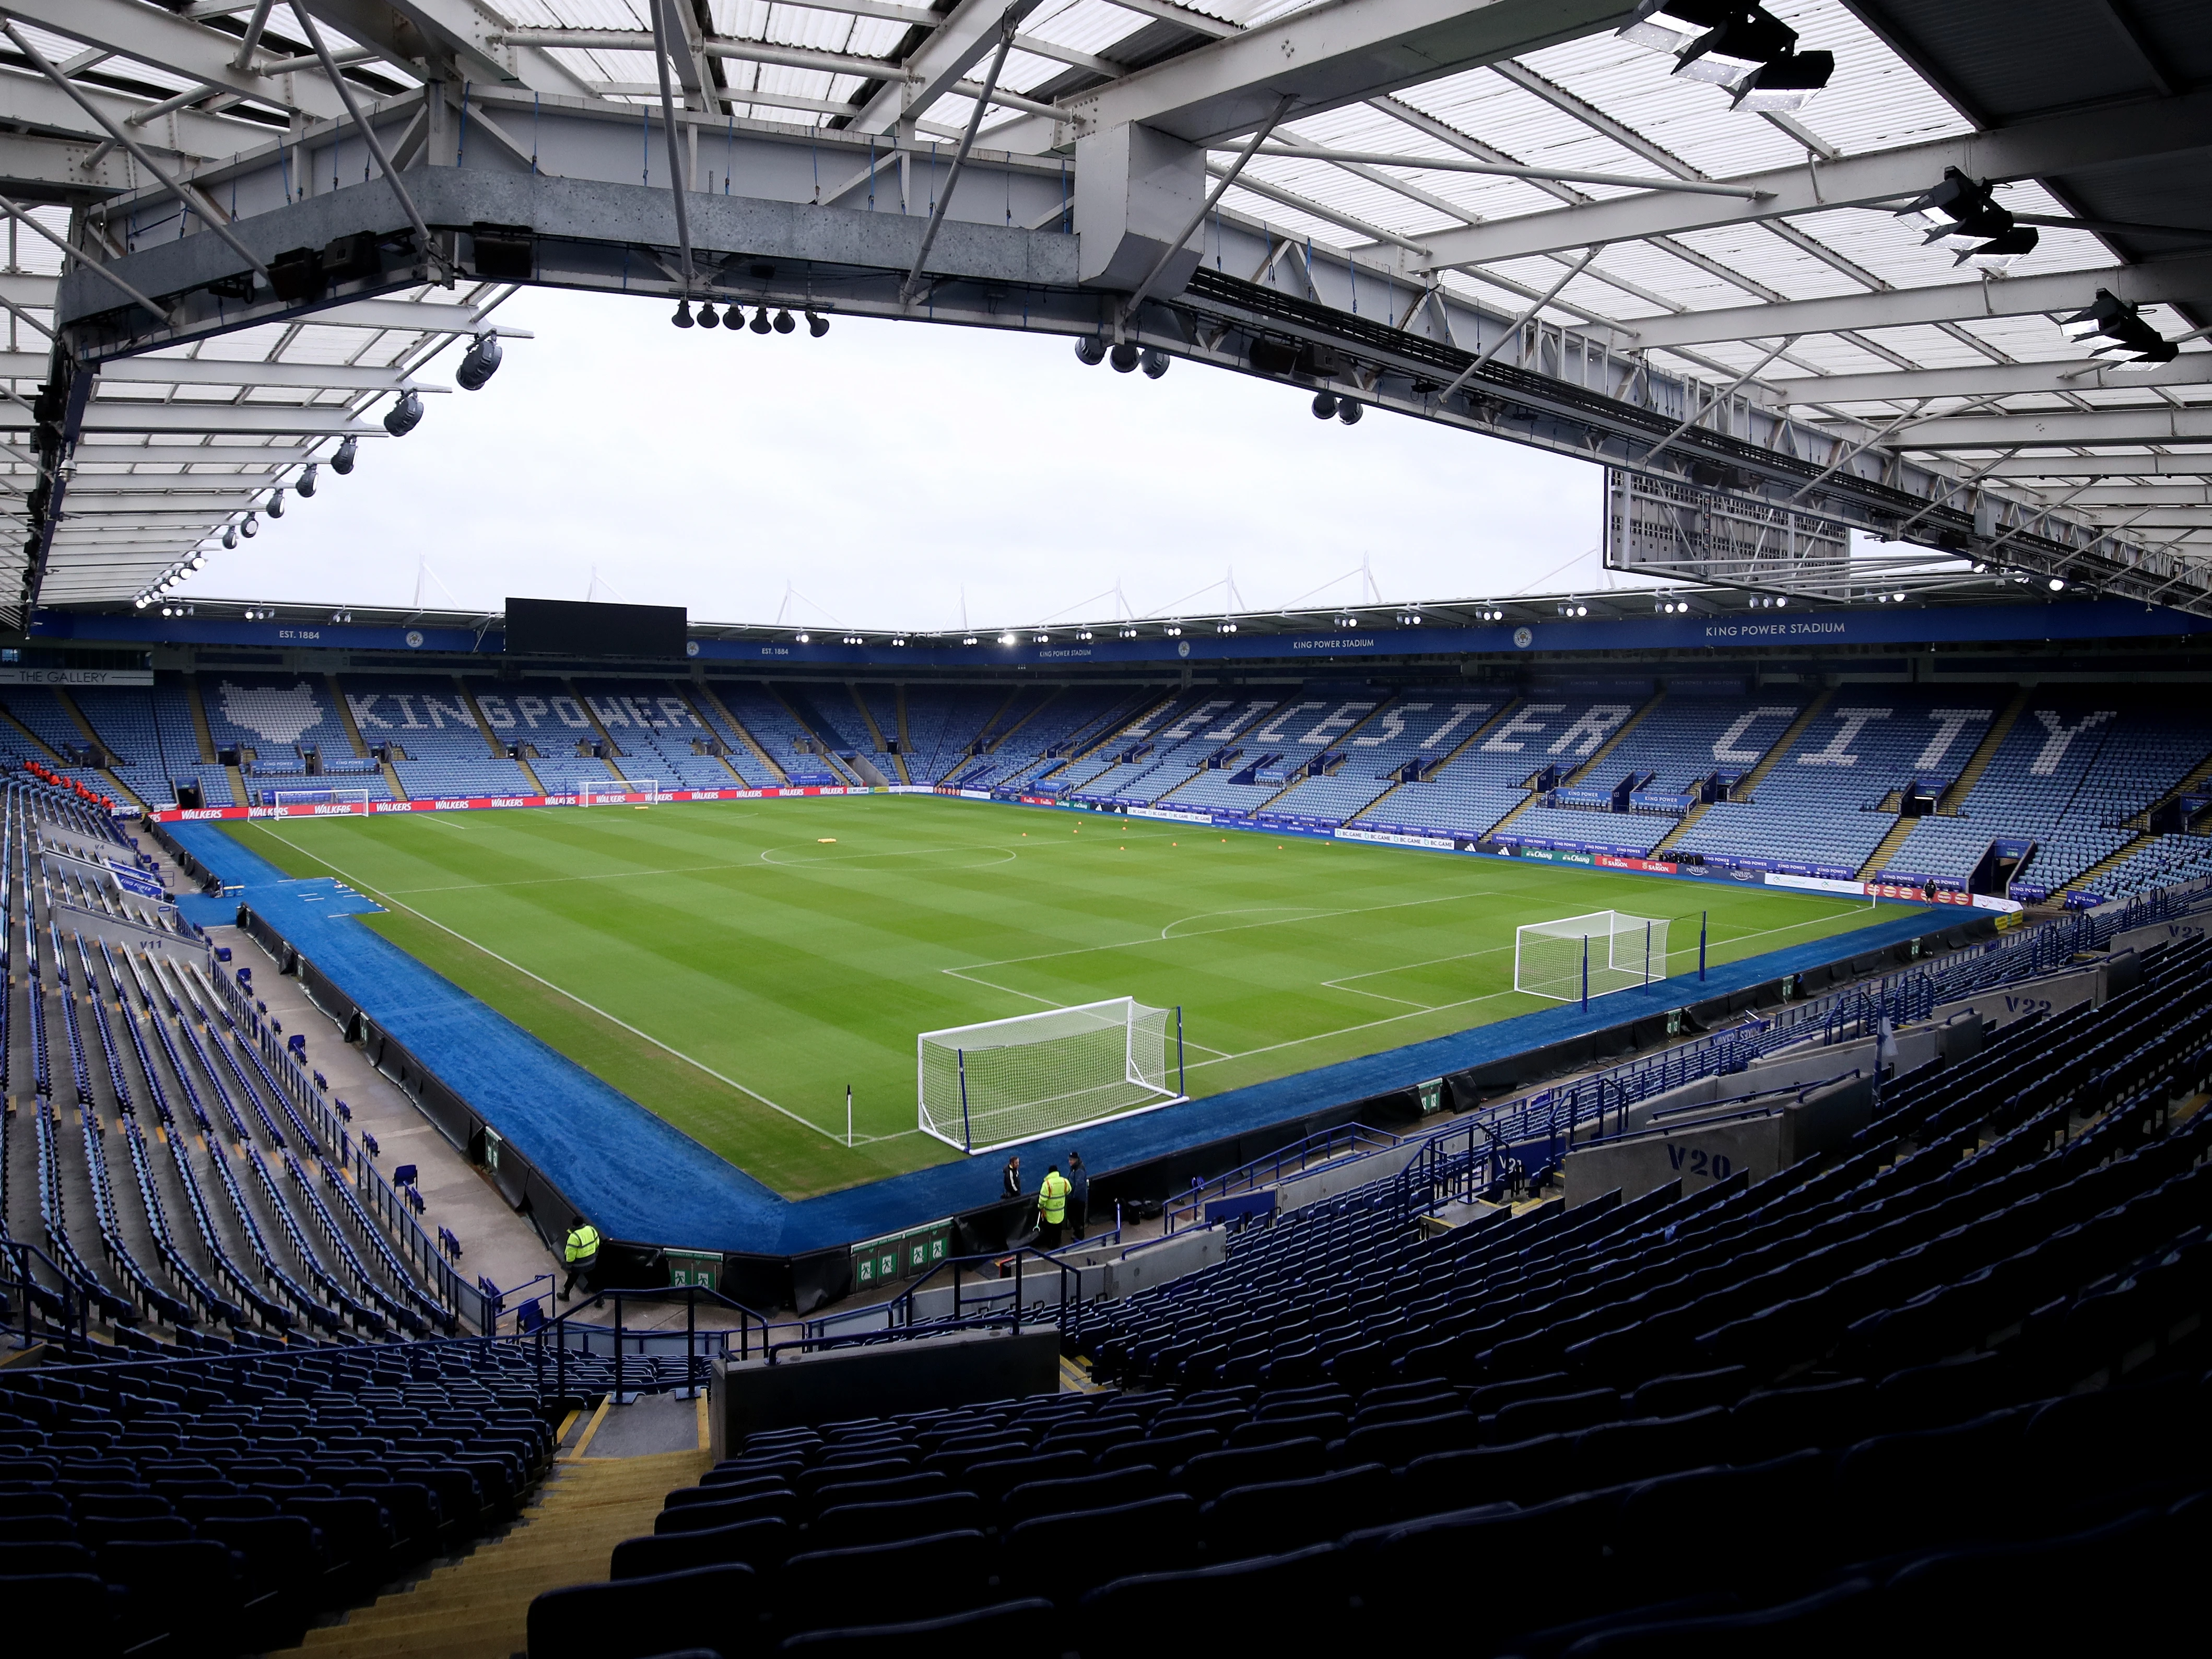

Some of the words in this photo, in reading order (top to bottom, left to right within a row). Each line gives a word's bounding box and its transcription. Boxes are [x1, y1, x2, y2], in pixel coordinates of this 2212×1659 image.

[1706, 627, 1737, 636] KING
[1742, 625, 1786, 635] POWER
[1790, 623, 1845, 633] STADIUM
[1342, 639, 1374, 648] STADIUM
[19, 671, 43, 682] THE
[47, 672, 108, 683] GALLERY
[1123, 701, 1631, 755] LEICESTER
[1712, 707, 2117, 774] CITY
[691, 791, 719, 799] WALKERS
[736, 790, 762, 798] WALKERS
[820, 786, 844, 795] WALKERS
[596, 794, 625, 803] WALKERS
[644, 793, 673, 802] WAKERS
[435, 801, 468, 809] WALKERS
[491, 798, 523, 807] WALKERS
[314, 804, 351, 814] WALKERS
[376, 803, 411, 812] WALKERS
[181, 809, 222, 819] WALKERS
[1535, 851, 1552, 860] Chang
[1571, 855, 1590, 864] Chang
[140, 940, 161, 949] V11
[2005, 995, 2052, 1017] V22
[1667, 1144, 1731, 1180] V20
